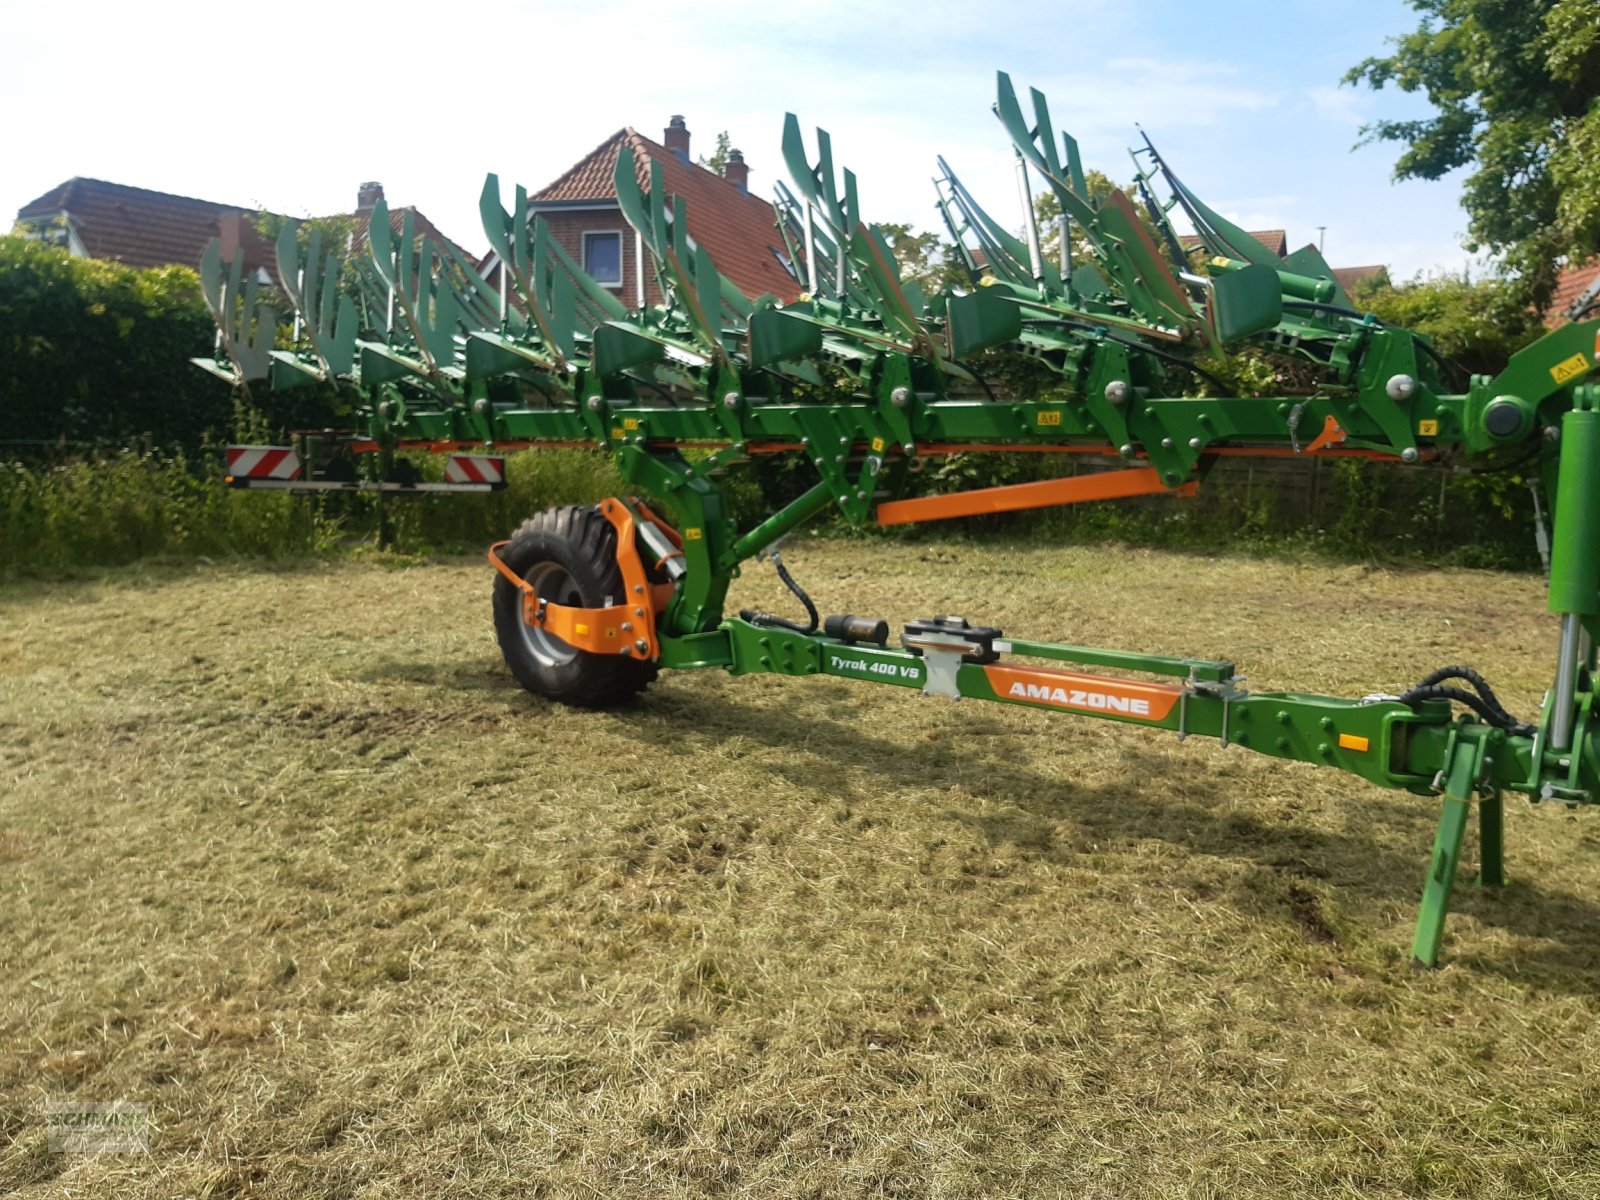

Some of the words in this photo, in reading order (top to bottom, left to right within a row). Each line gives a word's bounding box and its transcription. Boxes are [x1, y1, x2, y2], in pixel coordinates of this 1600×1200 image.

[831, 656, 867, 671] Tyrok
[869, 662, 897, 675] 400
[900, 666, 919, 678] VS
[1009, 682, 1150, 715] AMAZONE
